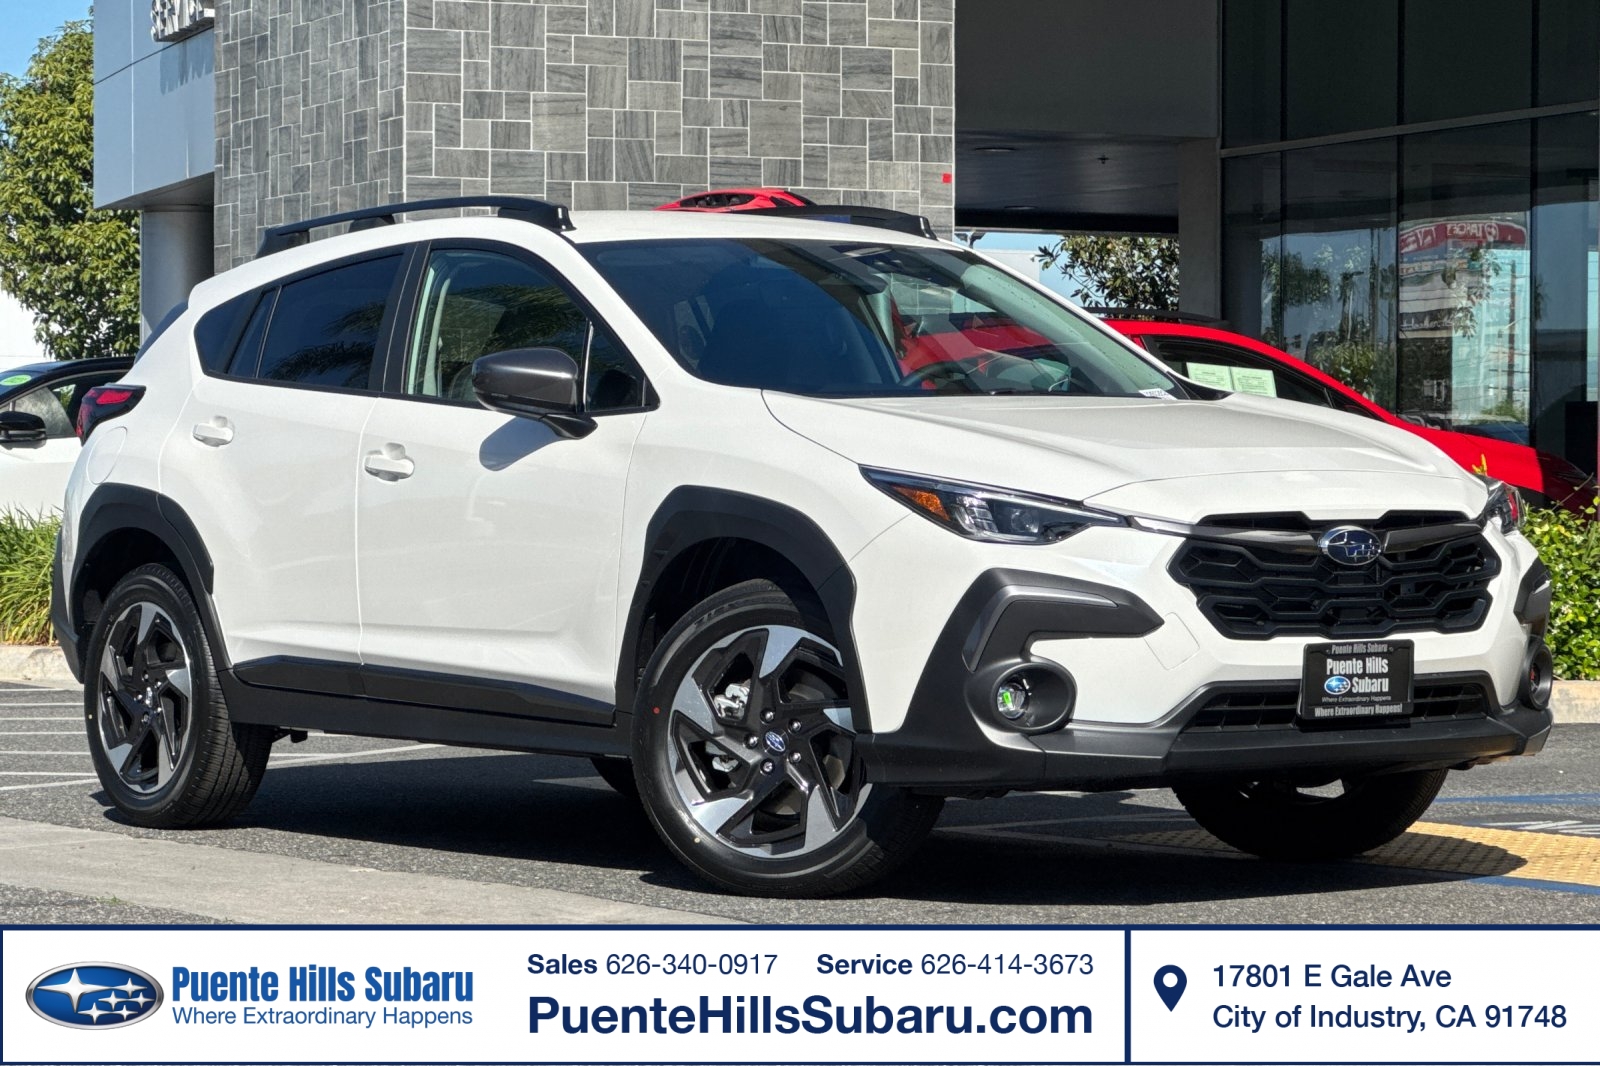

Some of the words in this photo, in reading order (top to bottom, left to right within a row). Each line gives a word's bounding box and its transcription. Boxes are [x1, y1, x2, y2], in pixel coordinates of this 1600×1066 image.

[1331, 645, 1353, 655] Puente
[1353, 643, 1367, 653] Hills
[1367, 643, 1388, 652] Subaru
[1326, 658, 1363, 675] Puente
[1365, 656, 1388, 673] Hills
[1352, 676, 1389, 693] Subaru
[1315, 707, 1334, 717] Where
[1335, 705, 1374, 716] Extraordinary
[1375, 703, 1403, 715] Happens!
